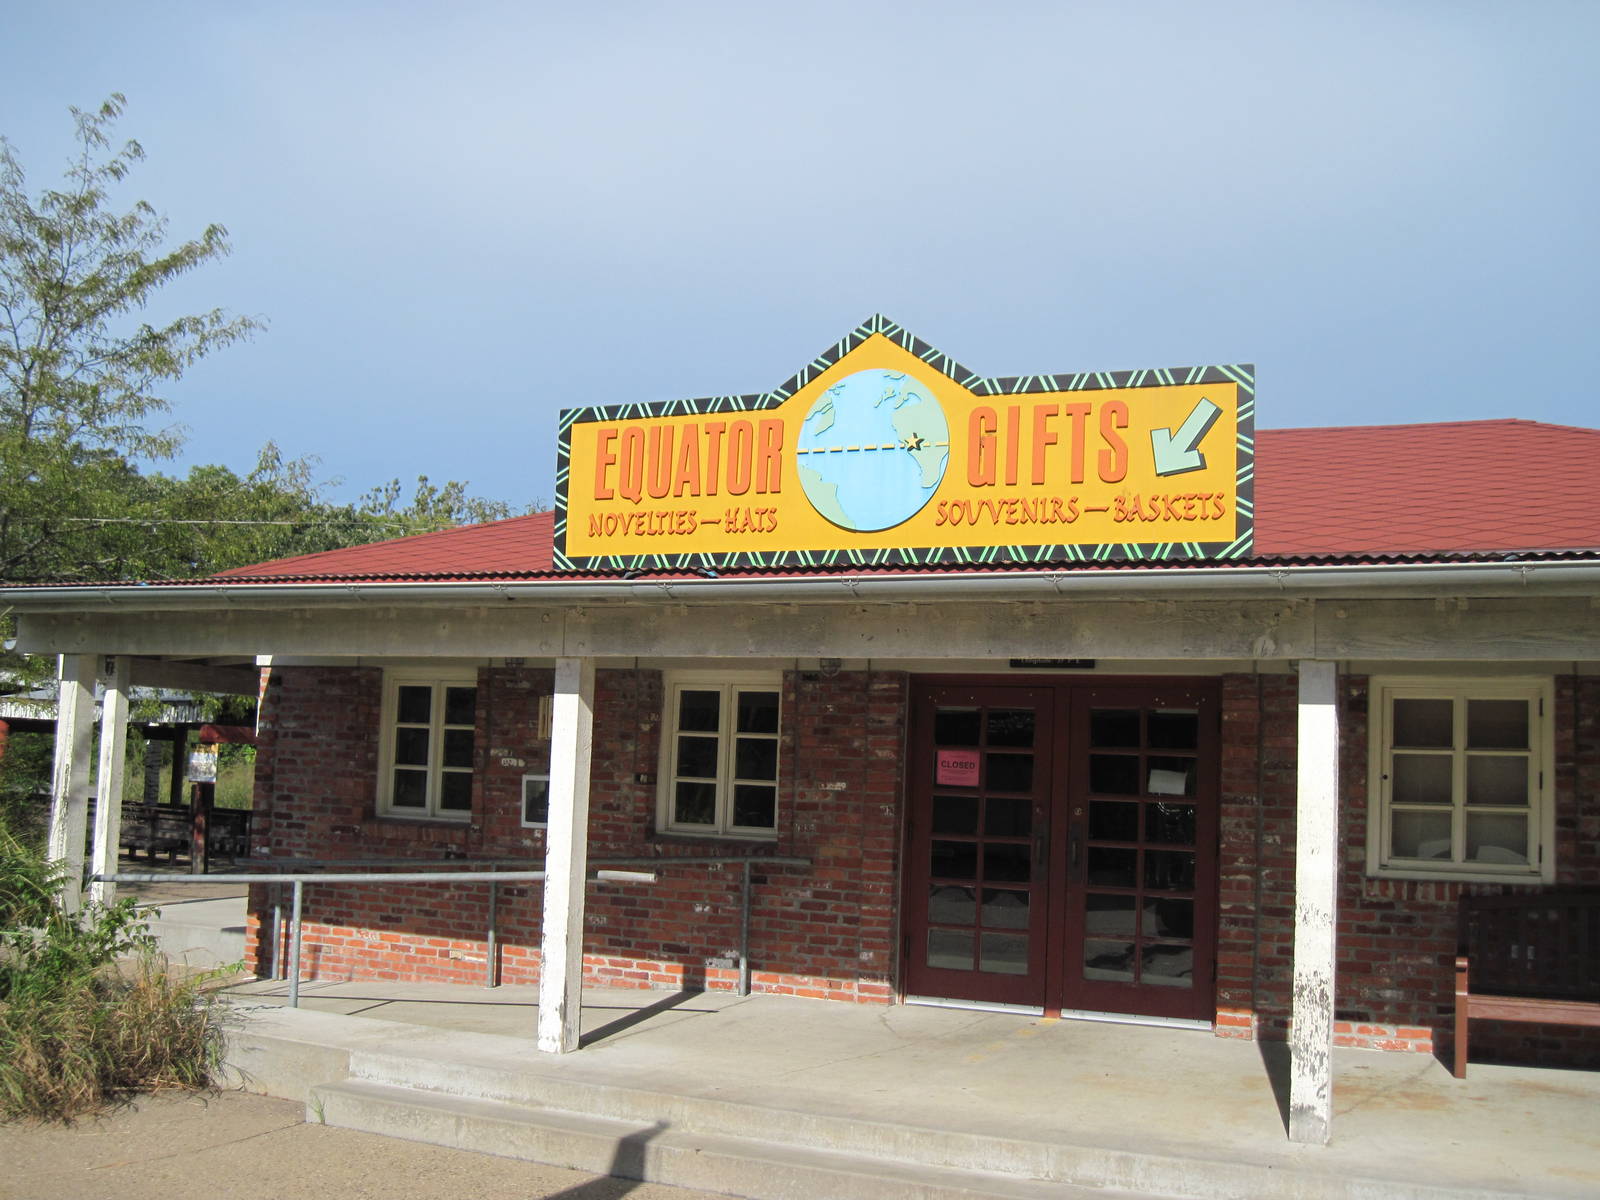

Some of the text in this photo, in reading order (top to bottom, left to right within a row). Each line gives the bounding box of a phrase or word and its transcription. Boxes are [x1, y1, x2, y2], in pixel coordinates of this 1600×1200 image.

[595, 418, 785, 504] EQUATOR
[967, 400, 1129, 487] GIFTS
[941, 760, 976, 770] CLOSED
